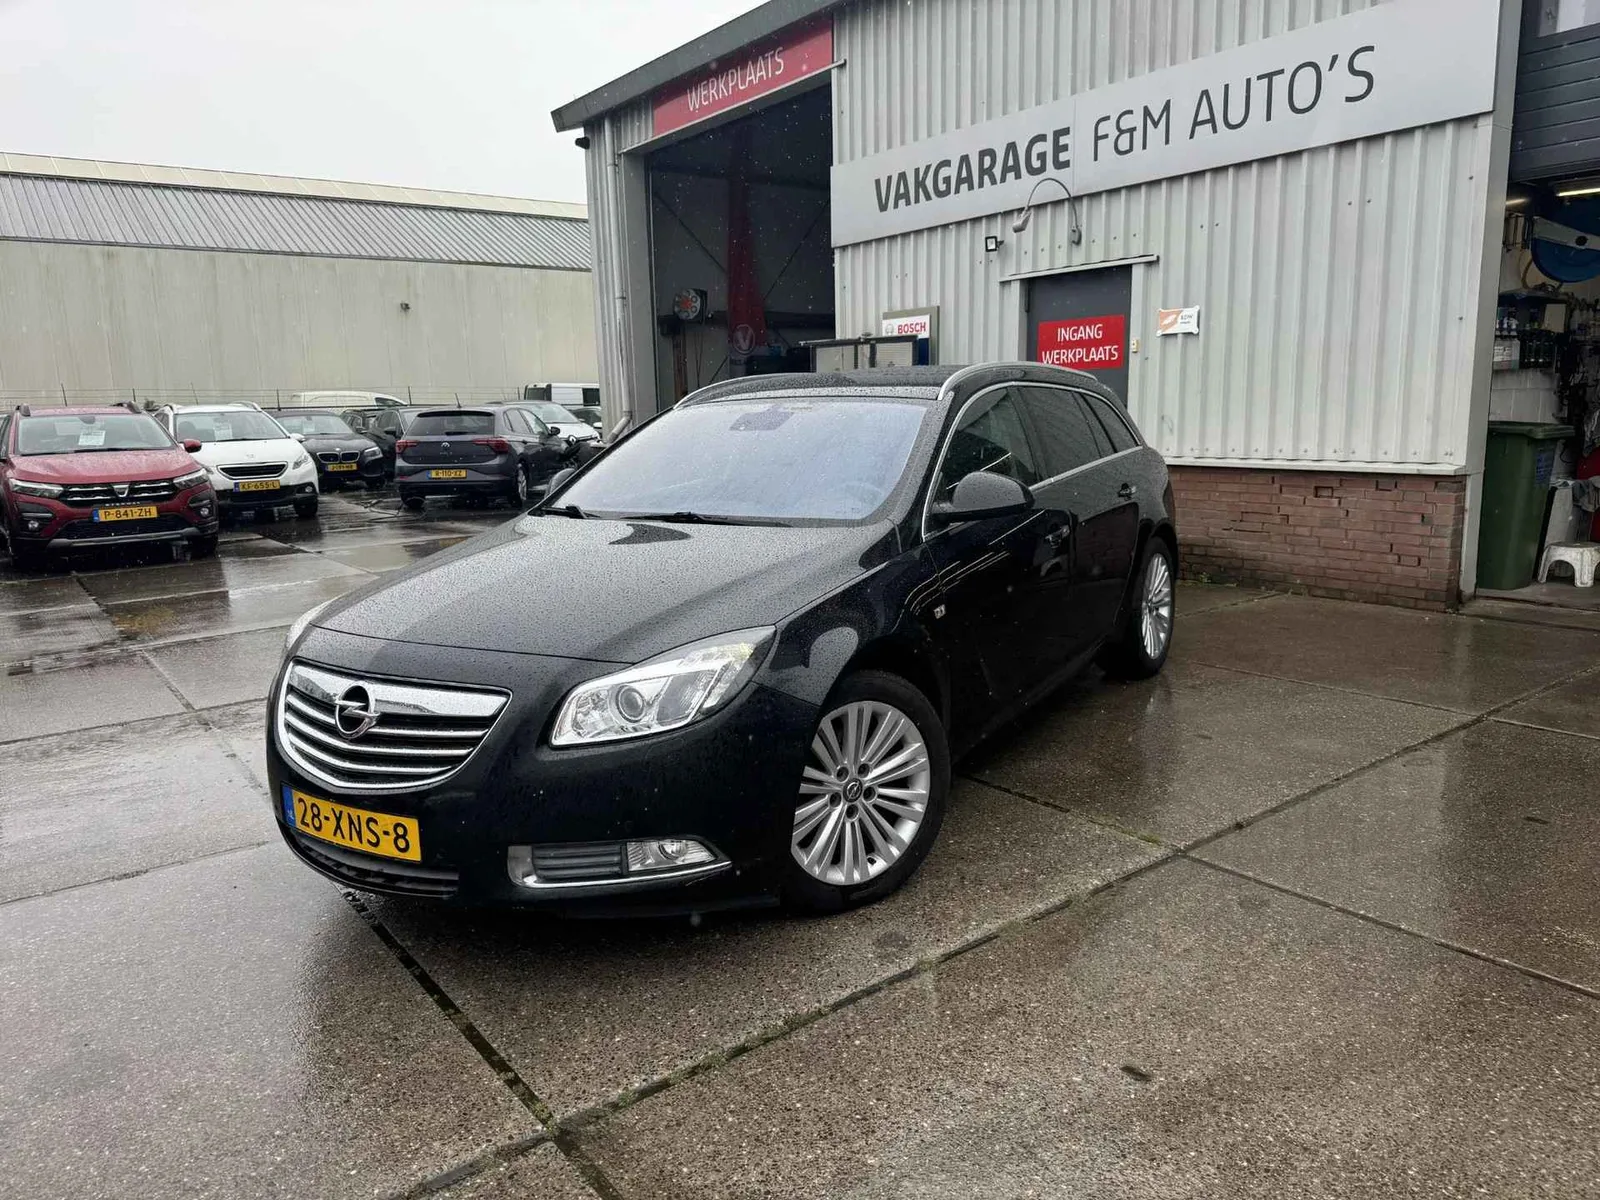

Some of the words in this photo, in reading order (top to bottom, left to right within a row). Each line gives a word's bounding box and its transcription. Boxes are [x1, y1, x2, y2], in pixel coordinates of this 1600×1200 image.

[686, 45, 785, 113] WERKPLAATS
[873, 126, 1071, 213] VAKGARAGE
[1092, 99, 1171, 162] F&M
[1188, 44, 1376, 141] AUTO'S
[897, 321, 927, 335] BOSCH
[1057, 323, 1103, 342] INGANG
[1041, 345, 1119, 365] WERKPLAATS
[104, 508, 152, 520] P-841-ZH
[297, 797, 411, 853] 28-XNS-8
